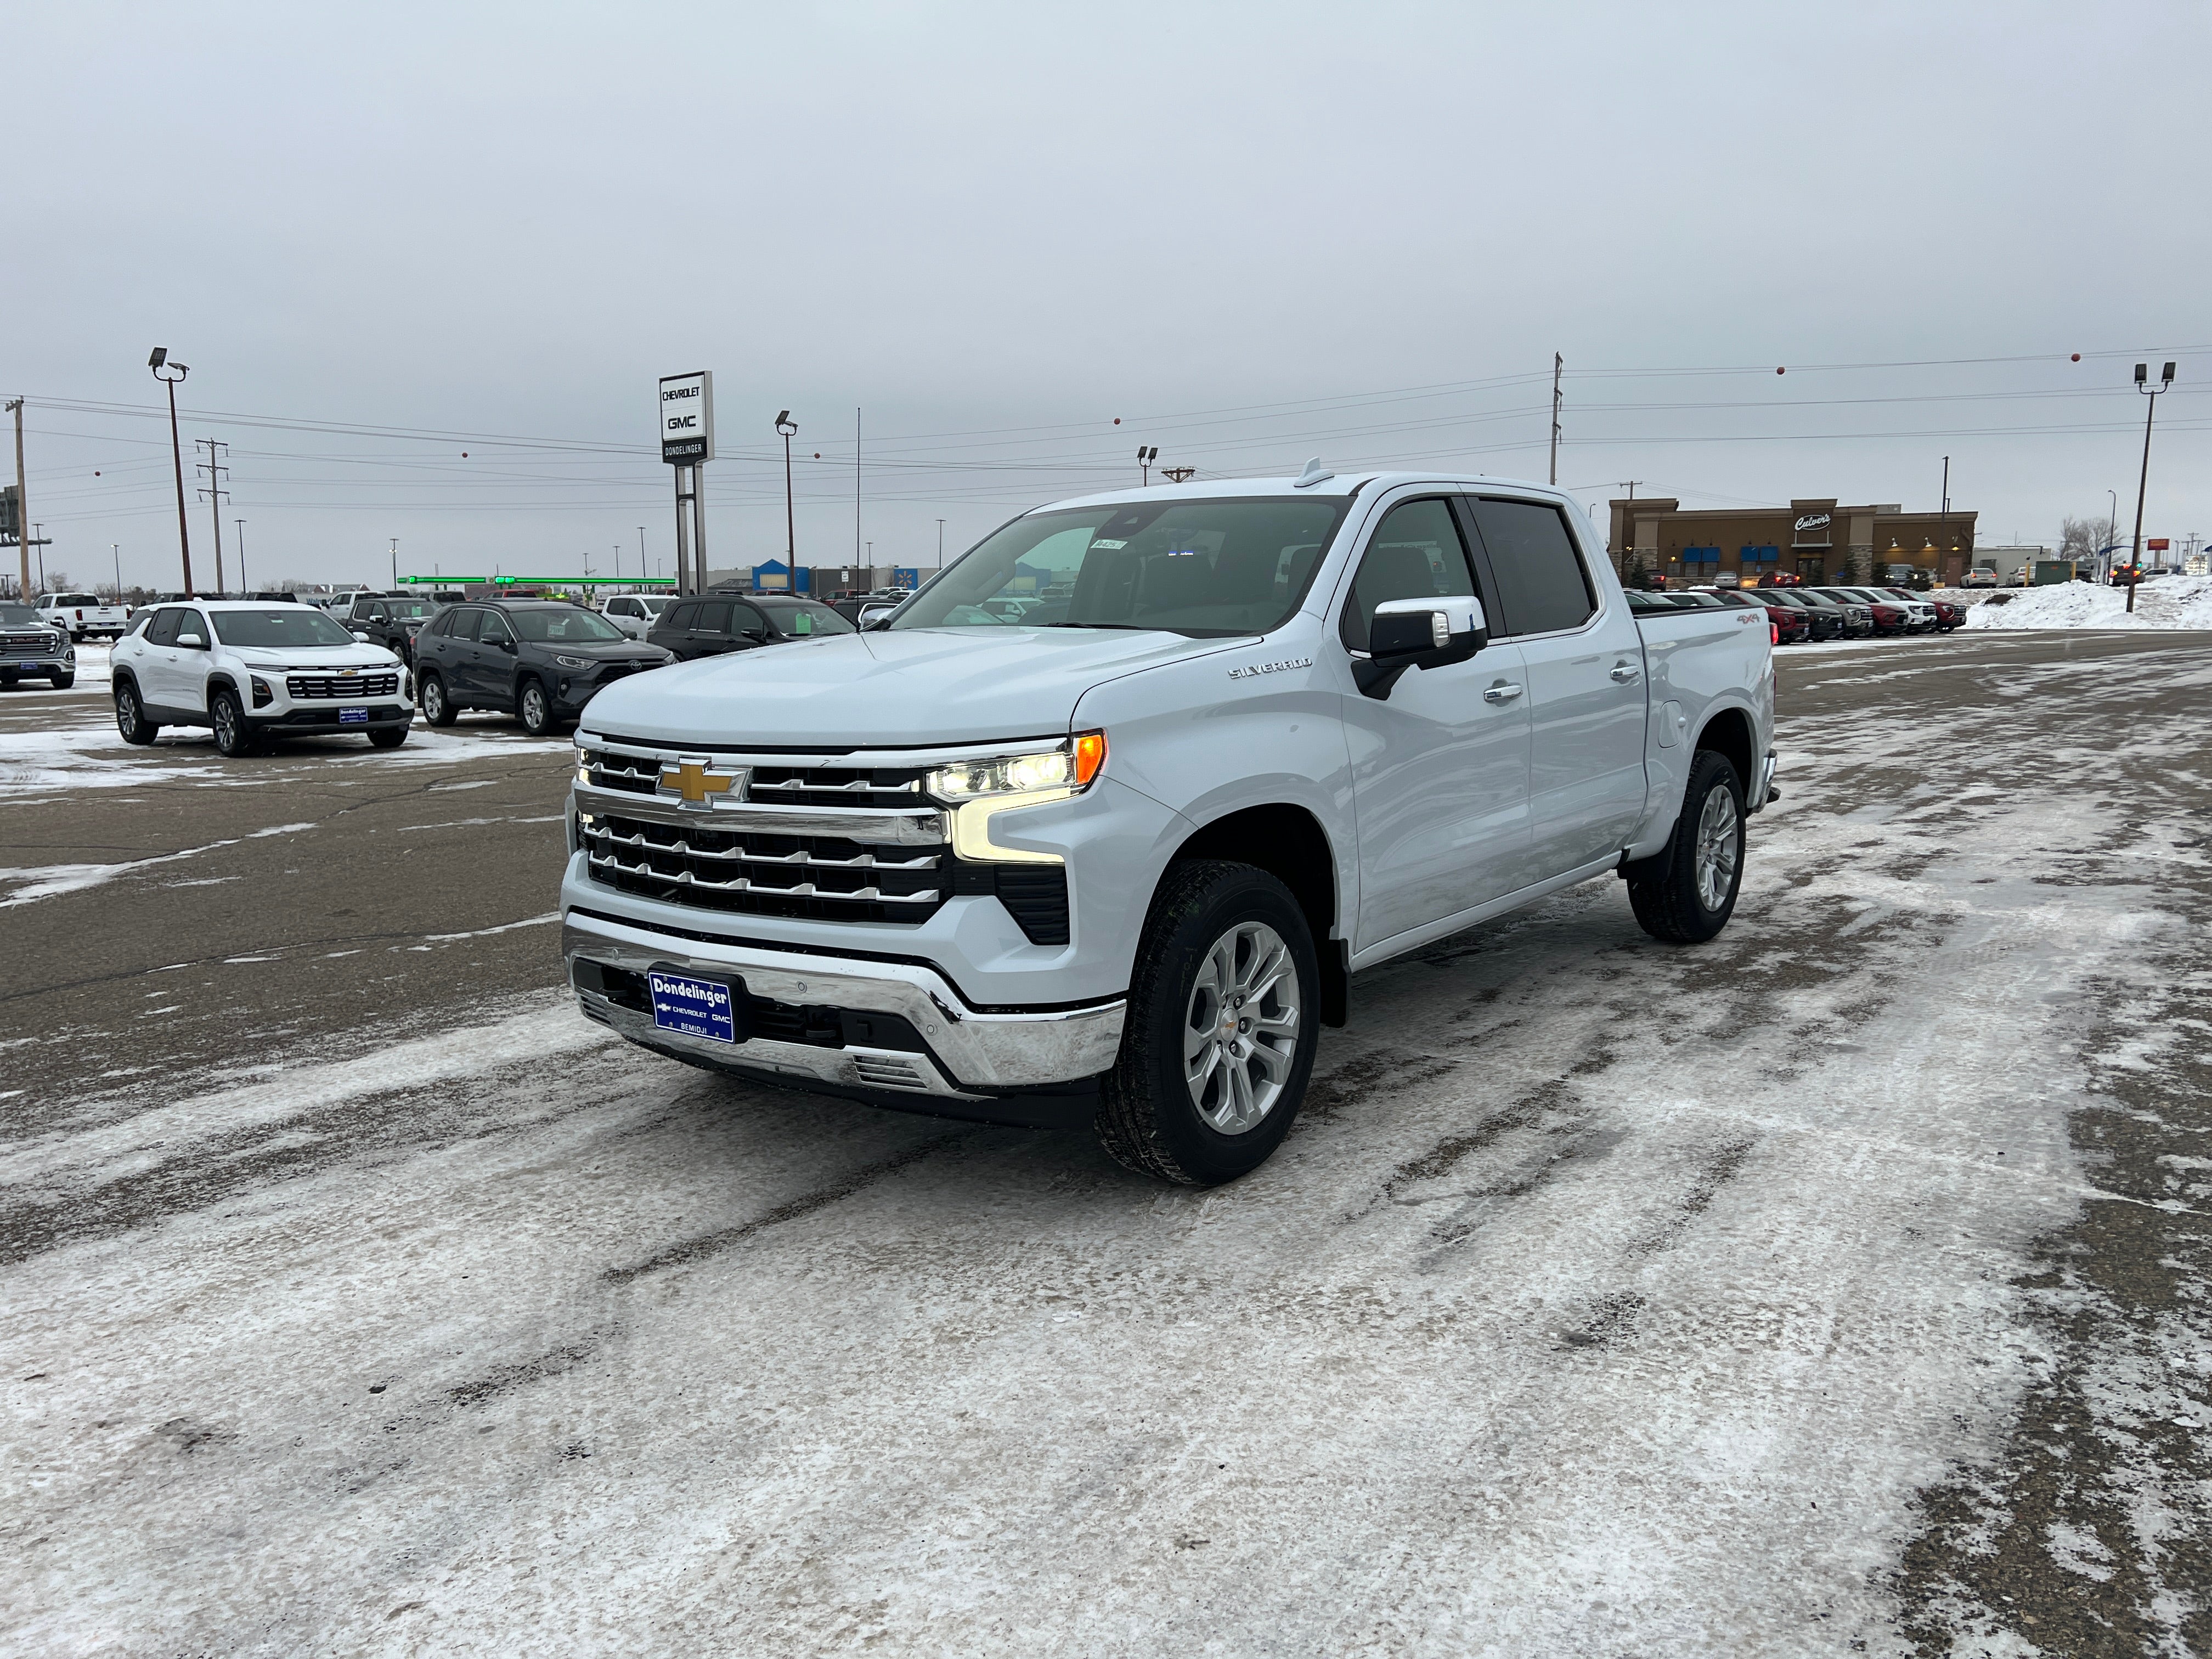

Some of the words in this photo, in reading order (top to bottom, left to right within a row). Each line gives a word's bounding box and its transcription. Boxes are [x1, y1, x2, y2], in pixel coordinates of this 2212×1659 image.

[662, 386, 699, 401] CHEVROLET
[668, 415, 696, 430] GMC
[665, 443, 702, 456] DONDELINGER
[1795, 514, 1831, 531] Culver's
[1228, 658, 1313, 679] SILVERADO
[653, 978, 727, 1008] Dondelinger
[673, 1006, 707, 1019] CHEVROLET
[712, 1014, 731, 1024] GMC
[681, 1023, 707, 1035] BEMIDJI
